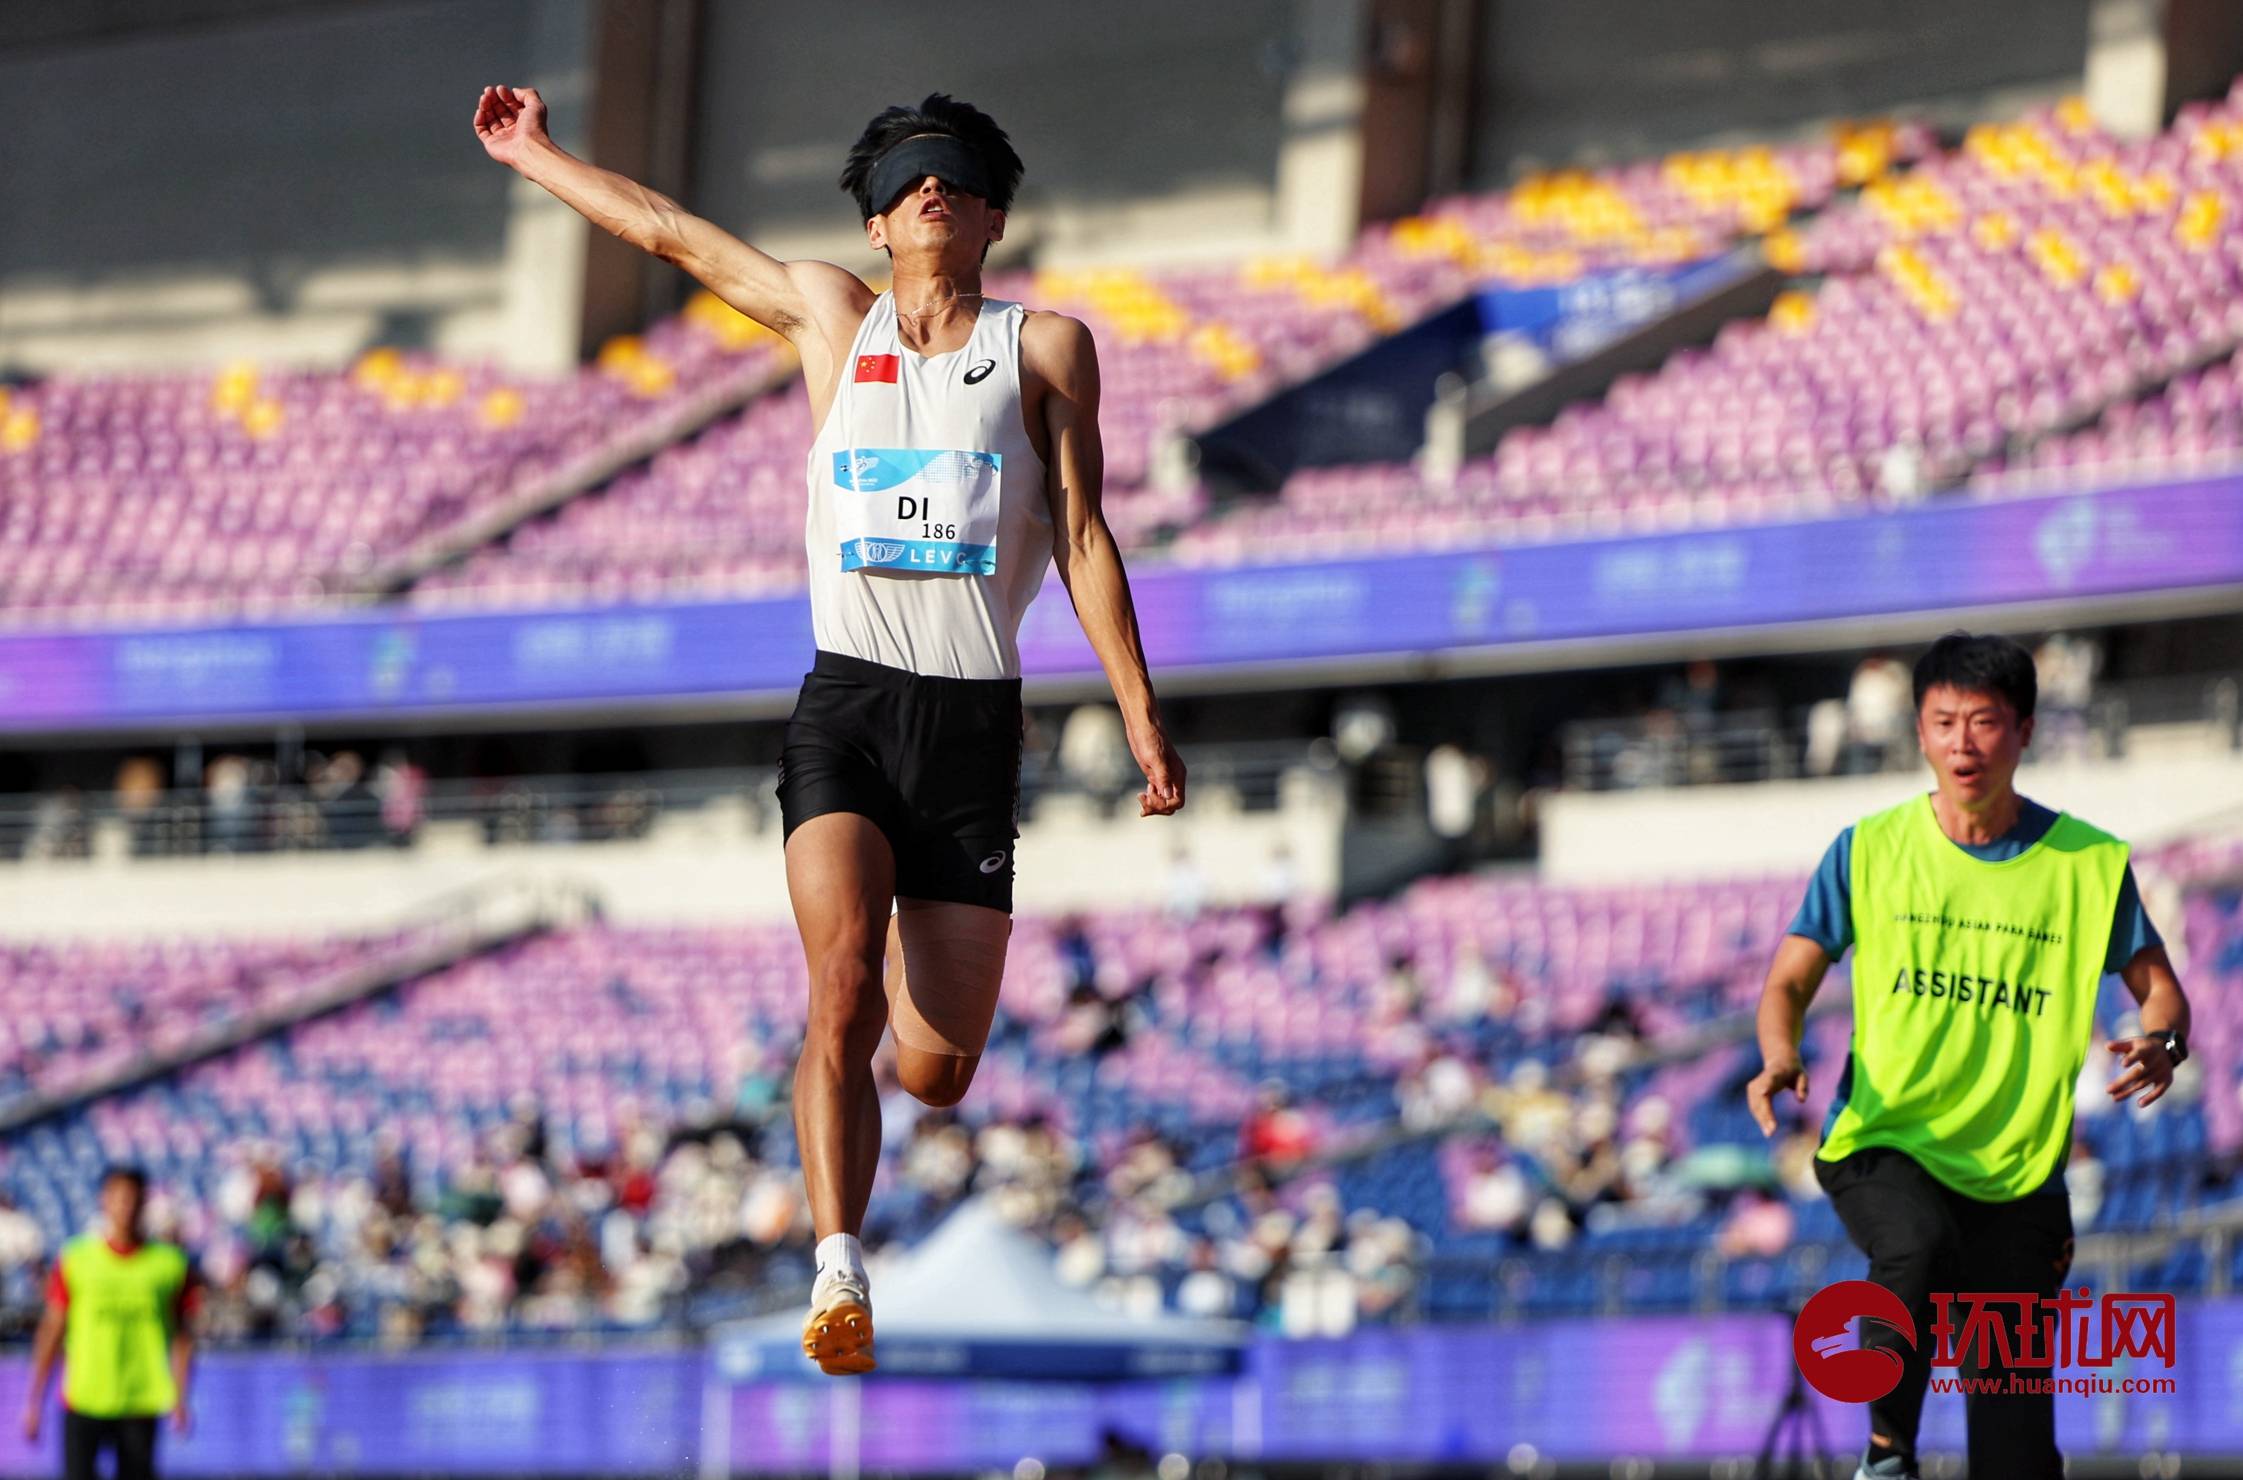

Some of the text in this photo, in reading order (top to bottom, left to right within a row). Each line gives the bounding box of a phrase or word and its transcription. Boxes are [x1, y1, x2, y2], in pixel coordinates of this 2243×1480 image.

[897, 496, 929, 521] DI
[921, 523, 956, 540] 186
[1996, 922, 2024, 937] PARA
[1892, 967, 2052, 1017] ASSISTANT
